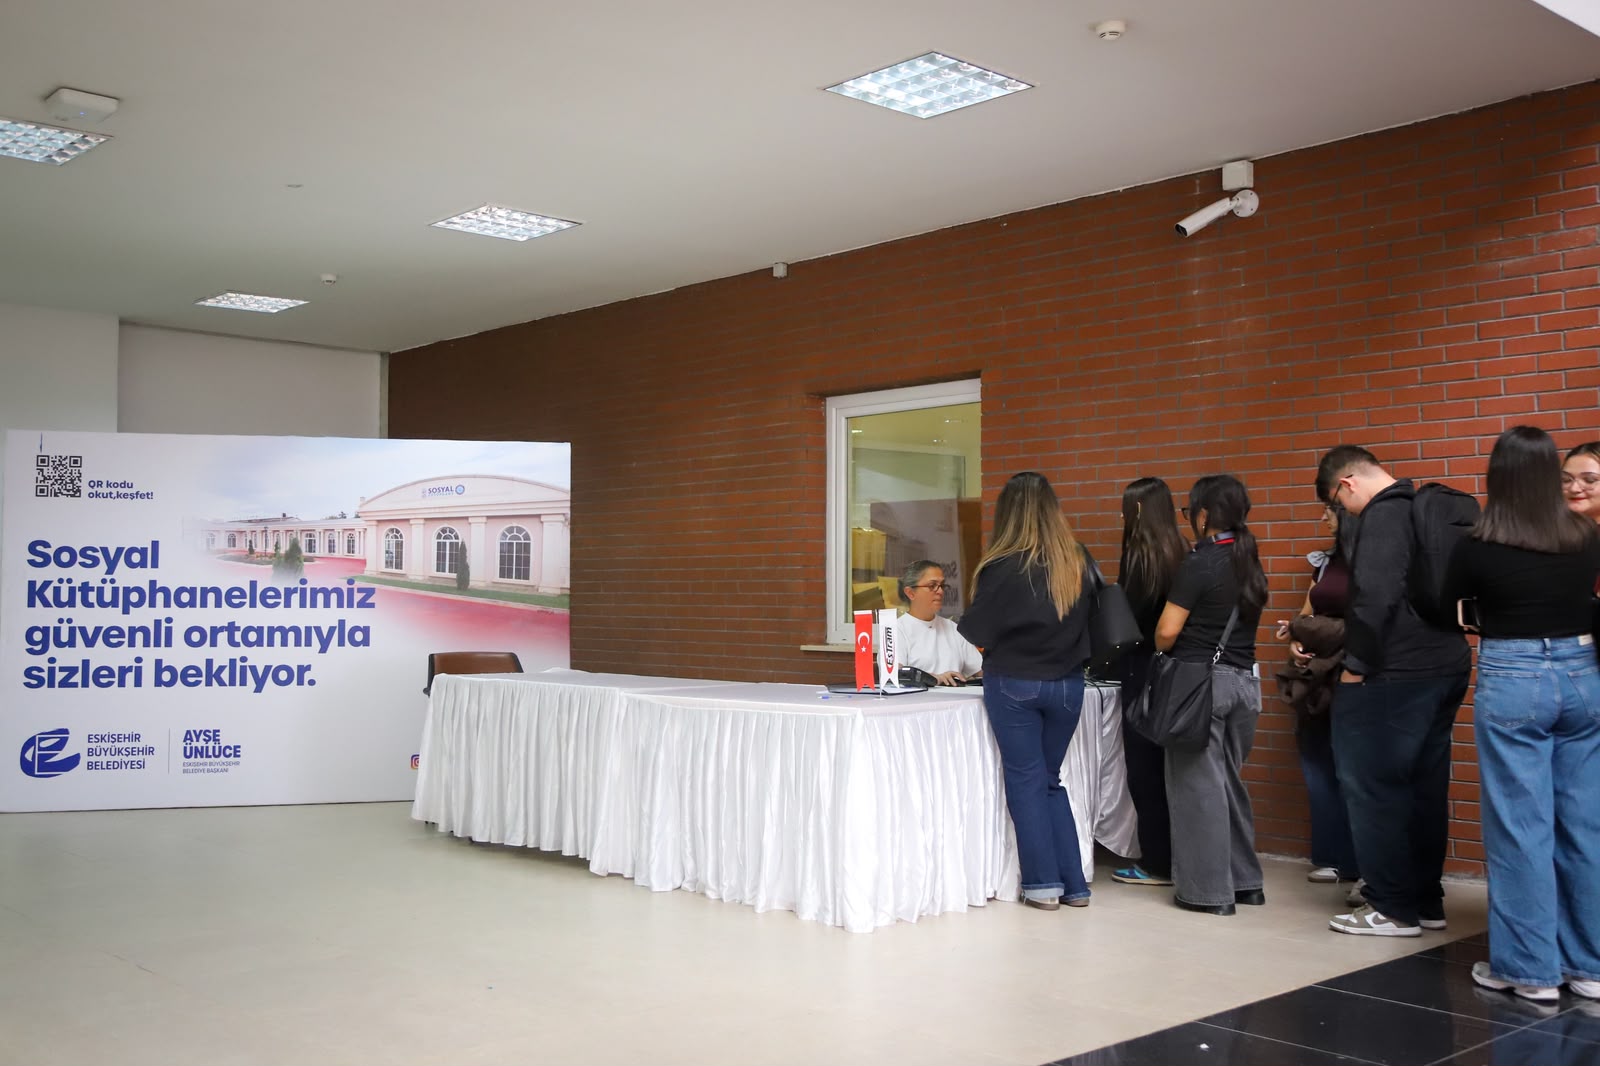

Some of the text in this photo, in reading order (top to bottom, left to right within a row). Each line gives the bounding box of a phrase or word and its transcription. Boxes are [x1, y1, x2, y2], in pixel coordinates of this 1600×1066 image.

[88, 480, 133, 489] QR kodu
[428, 486, 454, 494] SOSYAL
[88, 491, 153, 500] okut,keşfet!
[27, 540, 159, 575] Sosyal
[27, 578, 376, 615] Kütüphanelerimiz
[25, 617, 371, 655] güvenli ortamıyla
[23, 656, 316, 693] sizleri bekliyor.
[87, 733, 141, 745] ESKİŞEHİR
[183, 729, 221, 745] AYŞE
[87, 746, 155, 759] BÜYÜKŞEHİR
[183, 742, 242, 759] ÜNLÜCE
[87, 759, 146, 771] BELEDİYESİ
